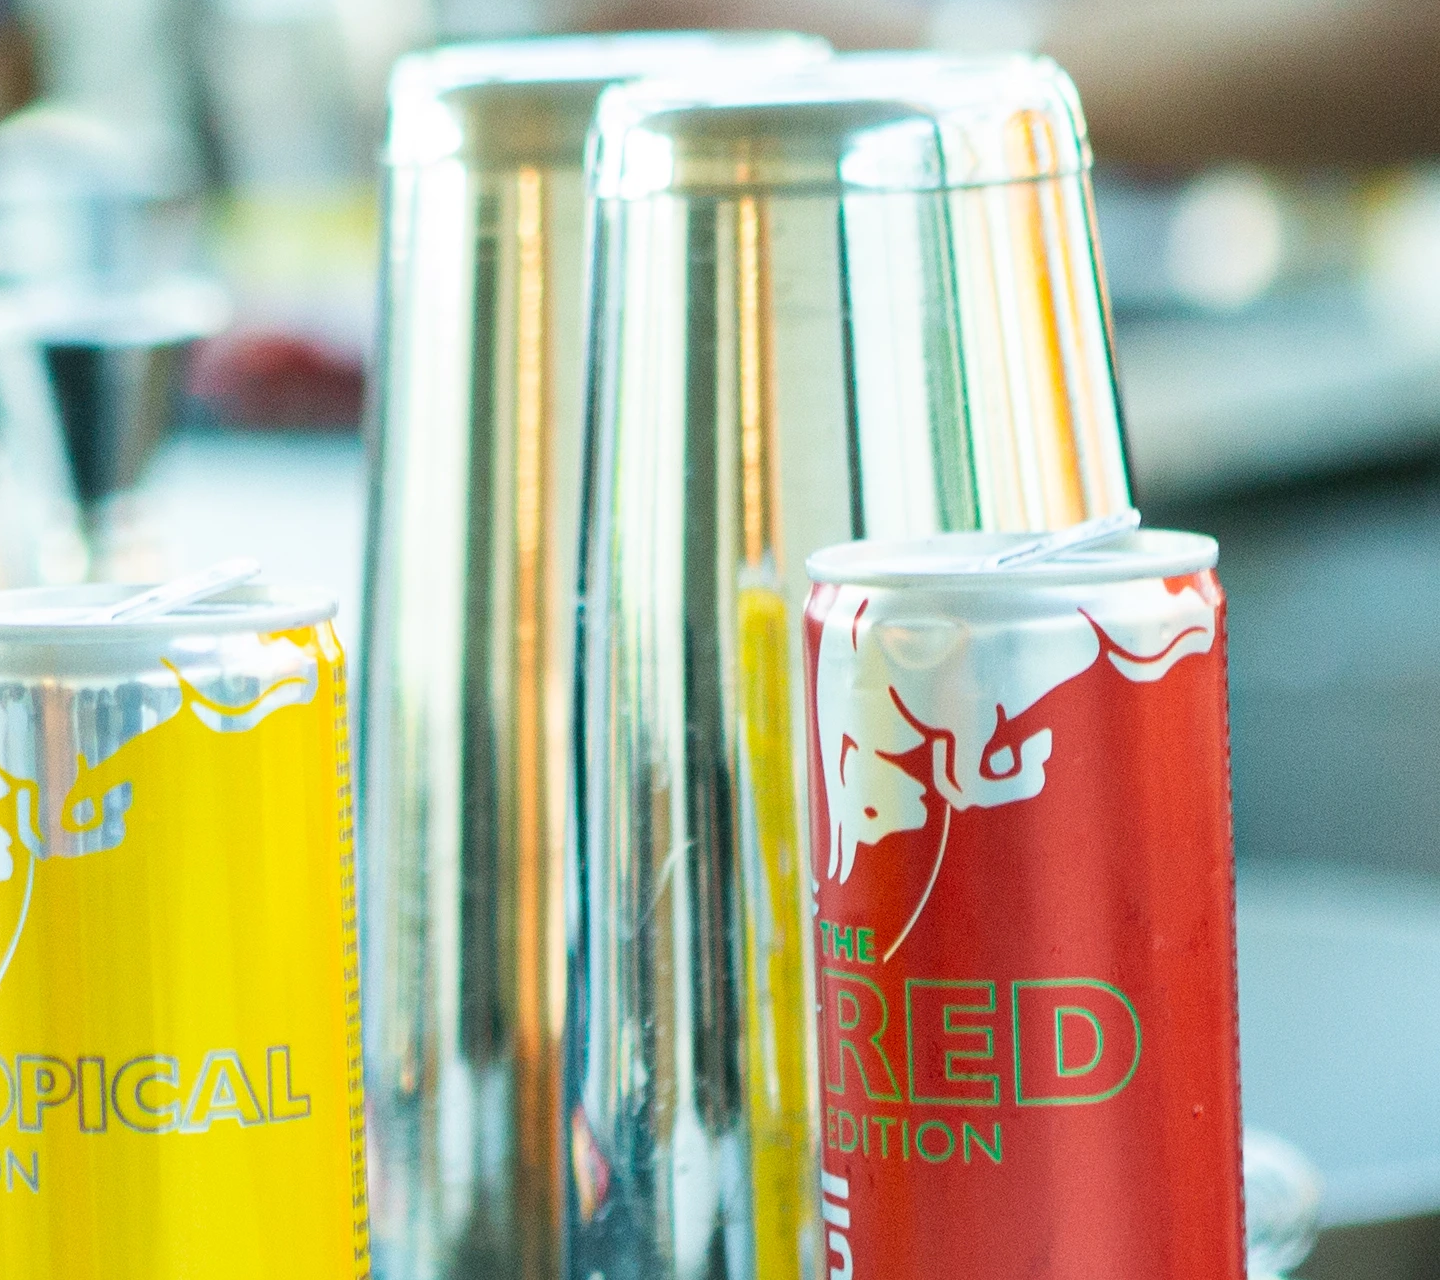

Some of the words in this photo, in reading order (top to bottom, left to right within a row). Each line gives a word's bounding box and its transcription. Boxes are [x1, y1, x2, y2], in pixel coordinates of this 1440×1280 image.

[820, 920, 876, 963] THE
[822, 967, 1142, 1106] RED
[826, 1105, 1002, 1164] EDITION
